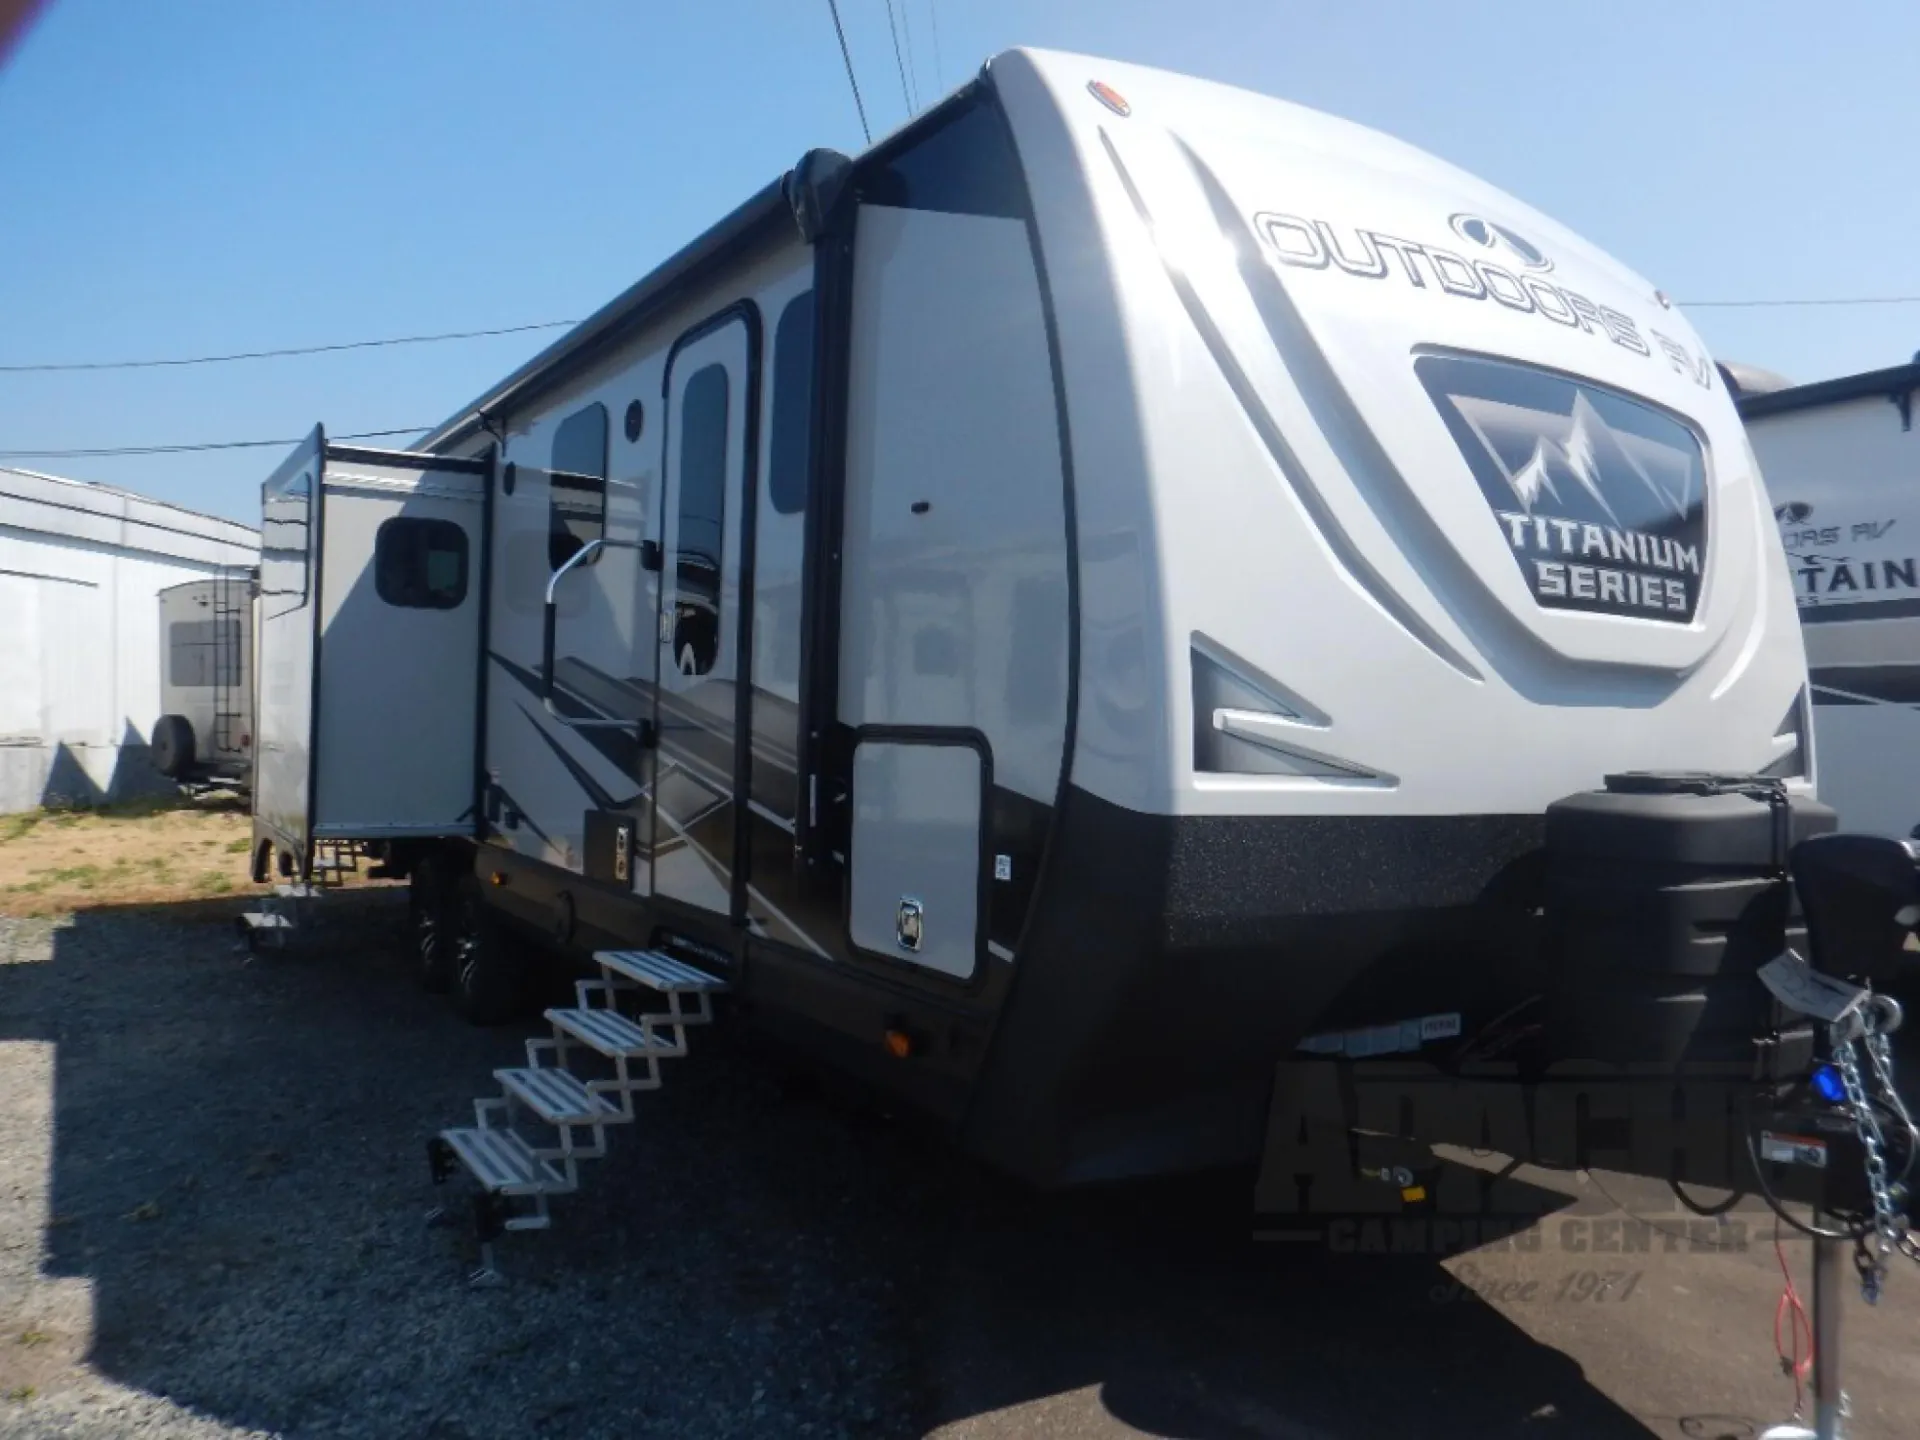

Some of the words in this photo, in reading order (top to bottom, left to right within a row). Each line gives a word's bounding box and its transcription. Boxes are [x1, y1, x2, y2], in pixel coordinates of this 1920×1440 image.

[1254, 211, 1649, 358] OUTDOORS
[1497, 511, 1700, 576] TITANIUM
[1532, 559, 1688, 613] SERIES
